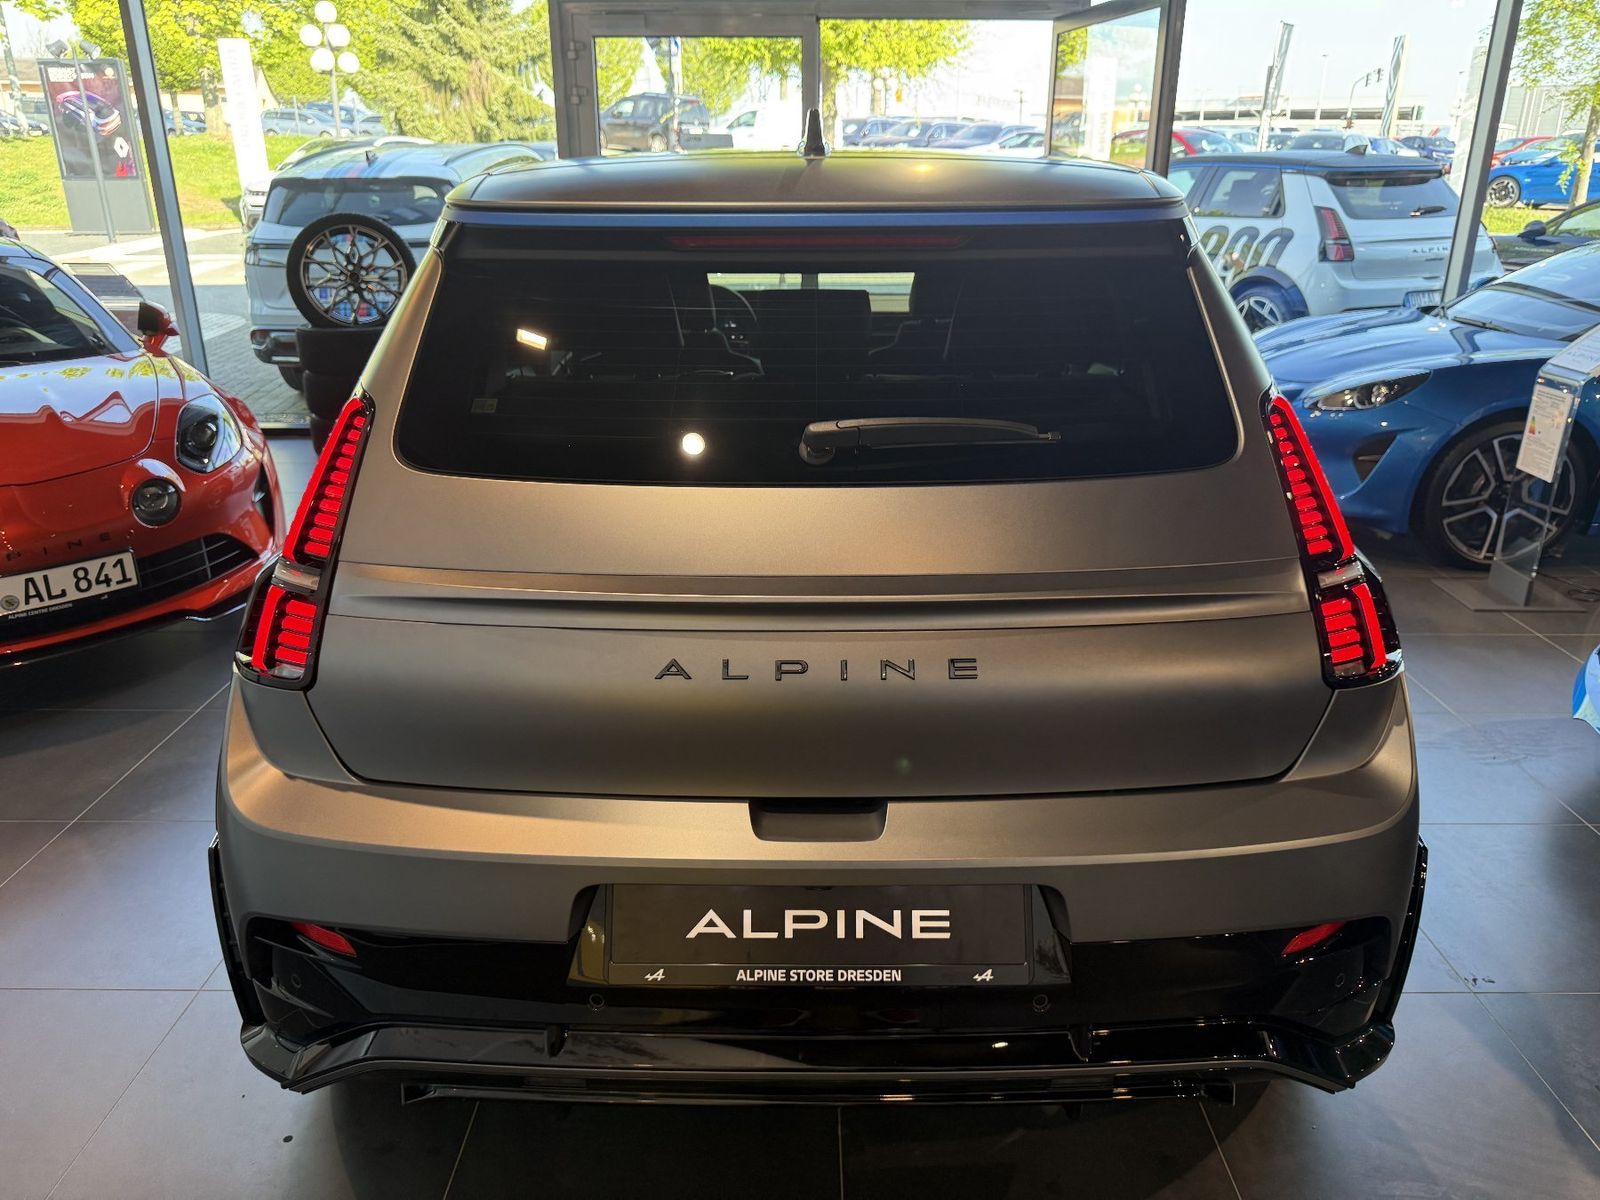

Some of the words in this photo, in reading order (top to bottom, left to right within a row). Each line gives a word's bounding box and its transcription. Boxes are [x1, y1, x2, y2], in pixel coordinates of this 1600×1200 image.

[1412, 246, 1448, 254] ALPIN
[24, 573, 67, 605] AL
[73, 558, 132, 593] 841
[28, 606, 49, 616] CENTRE
[655, 658, 978, 681] ALPINE
[686, 909, 951, 940] ALPINE
[736, 969, 786, 982] ALPINE
[790, 969, 834, 982] STORE
[837, 969, 902, 982] DRESDEN
